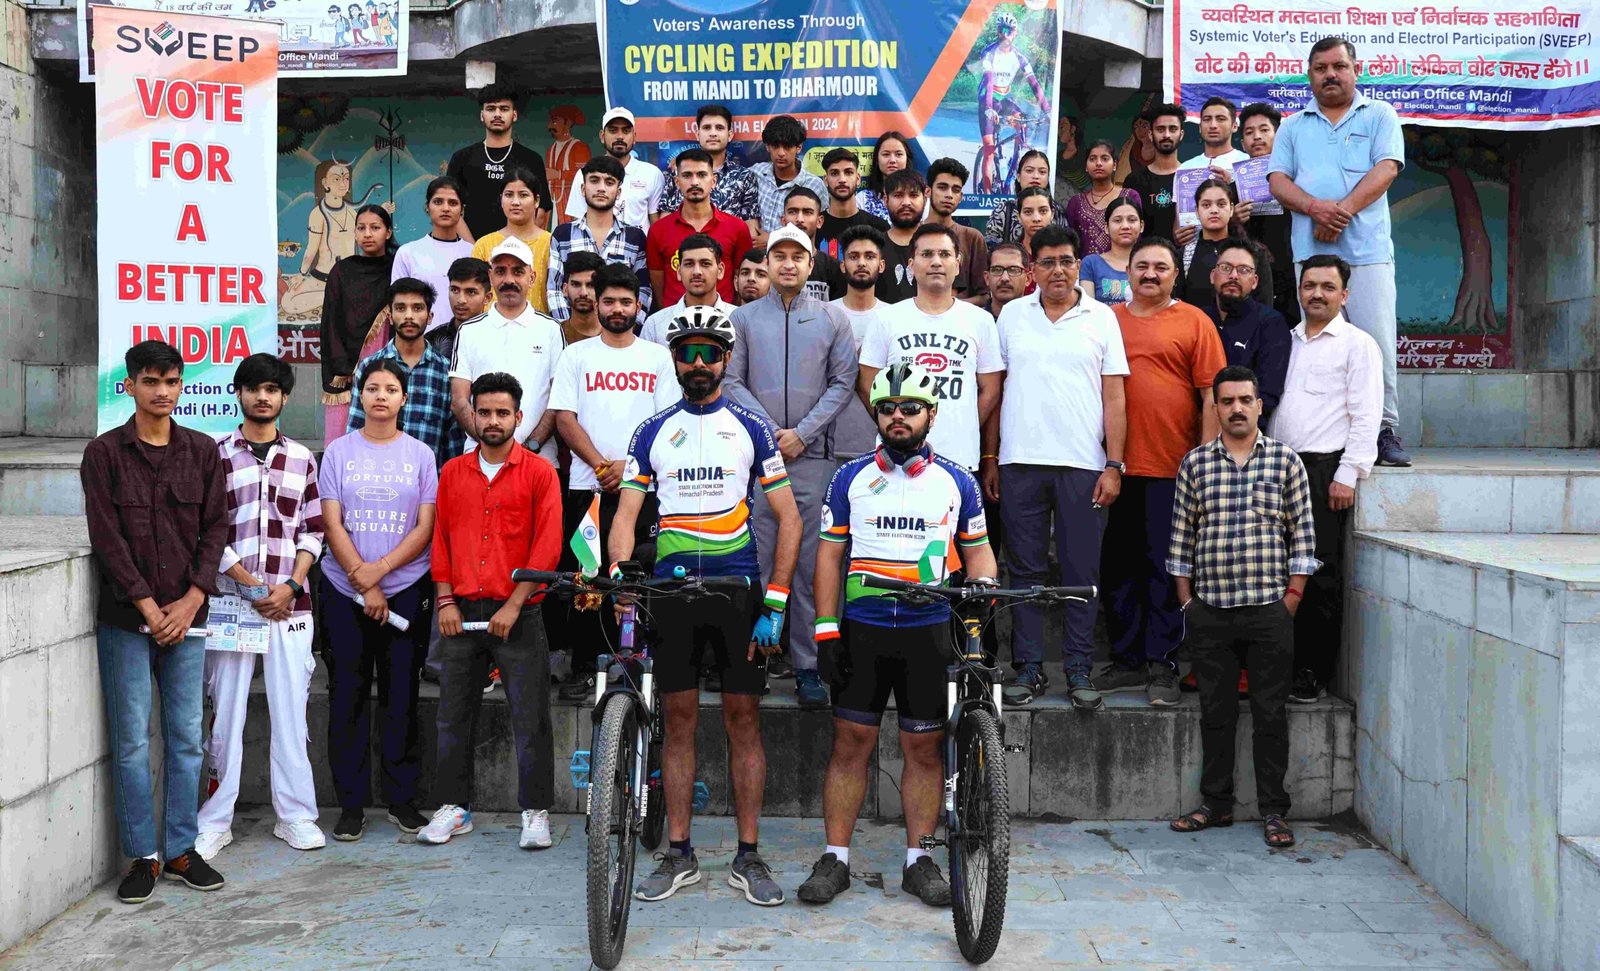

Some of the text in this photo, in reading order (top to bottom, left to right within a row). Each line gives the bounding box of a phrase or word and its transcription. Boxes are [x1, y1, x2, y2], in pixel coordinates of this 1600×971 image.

[653, 14, 864, 32] Voters' Awareness Through
[1202, 4, 1581, 28] व्यवस्थित मतदाता शिक्षा एवं निर्वाचक सहभागिता
[1190, 29, 1249, 44] Systemic
[1252, 30, 1296, 42] Voter's
[1371, 32, 1394, 43] and
[1398, 32, 1448, 44] Electrol
[1453, 33, 1535, 46] Participation
[1540, 33, 1591, 49] (SVEEP)
[279, 52, 339, 61] Office Mandi
[624, 40, 897, 74] CYCLING EXPEDITION
[1195, 52, 1223, 74] वोट
[1227, 52, 1250, 74] की
[1411, 54, 1462, 76] लेकिन
[1467, 55, 1497, 76] वोट
[1500, 60, 1541, 79] जरूर
[643, 76, 878, 101] FROM MANDI TO BHARMOUR
[1364, 88, 1512, 103] Election Office Mandi
[136, 78, 243, 122] VOTE
[1477, 105, 1539, 113] @election_mandi
[812, 117, 838, 131] 2024
[152, 142, 232, 182] FOR
[177, 204, 206, 241] A
[118, 263, 266, 304] BETTER
[898, 333, 969, 359] UNLTD.
[949, 359, 961, 367] TMK
[586, 371, 657, 393] LACOSTE
[202, 403, 238, 417] (H.P.)
[732, 405, 743, 414] AM
[747, 413, 766, 428] SMART
[763, 428, 774, 450] VOTER
[346, 474, 412, 485] FORTUNE
[678, 466, 723, 481] INDIA
[954, 465, 975, 482] SMART
[974, 483, 982, 508] VOTER
[345, 509, 407, 522] FUTURE
[876, 516, 926, 532] INDIA
[346, 522, 405, 534] VISUALS
[288, 622, 306, 632] AIR
